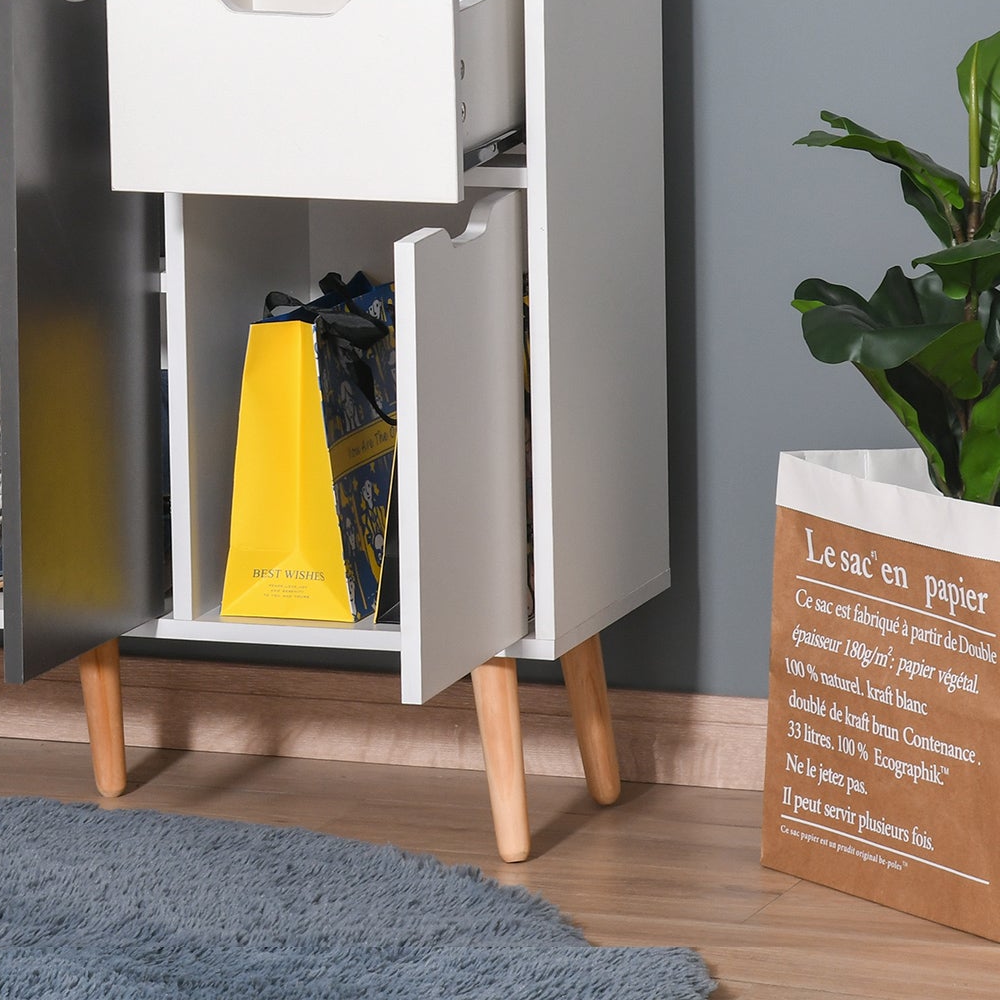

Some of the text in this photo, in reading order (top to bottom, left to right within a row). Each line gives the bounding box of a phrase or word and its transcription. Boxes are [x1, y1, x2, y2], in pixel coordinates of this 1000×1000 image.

[252, 568, 326, 582] BEST WISHES
[805, 527, 836, 568] Le
[881, 563, 909, 589] en
[924, 574, 988, 617] papier
[795, 588, 997, 664] Ce sac est fabriqué à partir de Double
[784, 657, 806, 679] 100
[820, 672, 865, 697] naturel.
[866, 680, 894, 706] kraft
[895, 688, 928, 716] blanc
[791, 624, 842, 654] épaisseur
[896, 657, 936, 680] papier
[938, 667, 979, 694] végétal.
[787, 720, 802, 739] 33
[803, 723, 835, 751] litres.
[837, 735, 856, 757] 100
[788, 689, 827, 718] doublé
[829, 702, 843, 722] de
[844, 706, 870, 732] kraft
[871, 715, 900, 742] brun
[902, 726, 976, 764] Contenance
[785, 752, 868, 795] Ne le jetez pas.
[780, 824, 790, 834] Ce
[790, 828, 800, 838] sac
[800, 832, 820, 843] papier
[820, 837, 829, 847] est
[829, 841, 837, 849] un
[856, 849, 878, 863] original
[782, 786, 935, 851] Il peut servir plusieurs fois.
